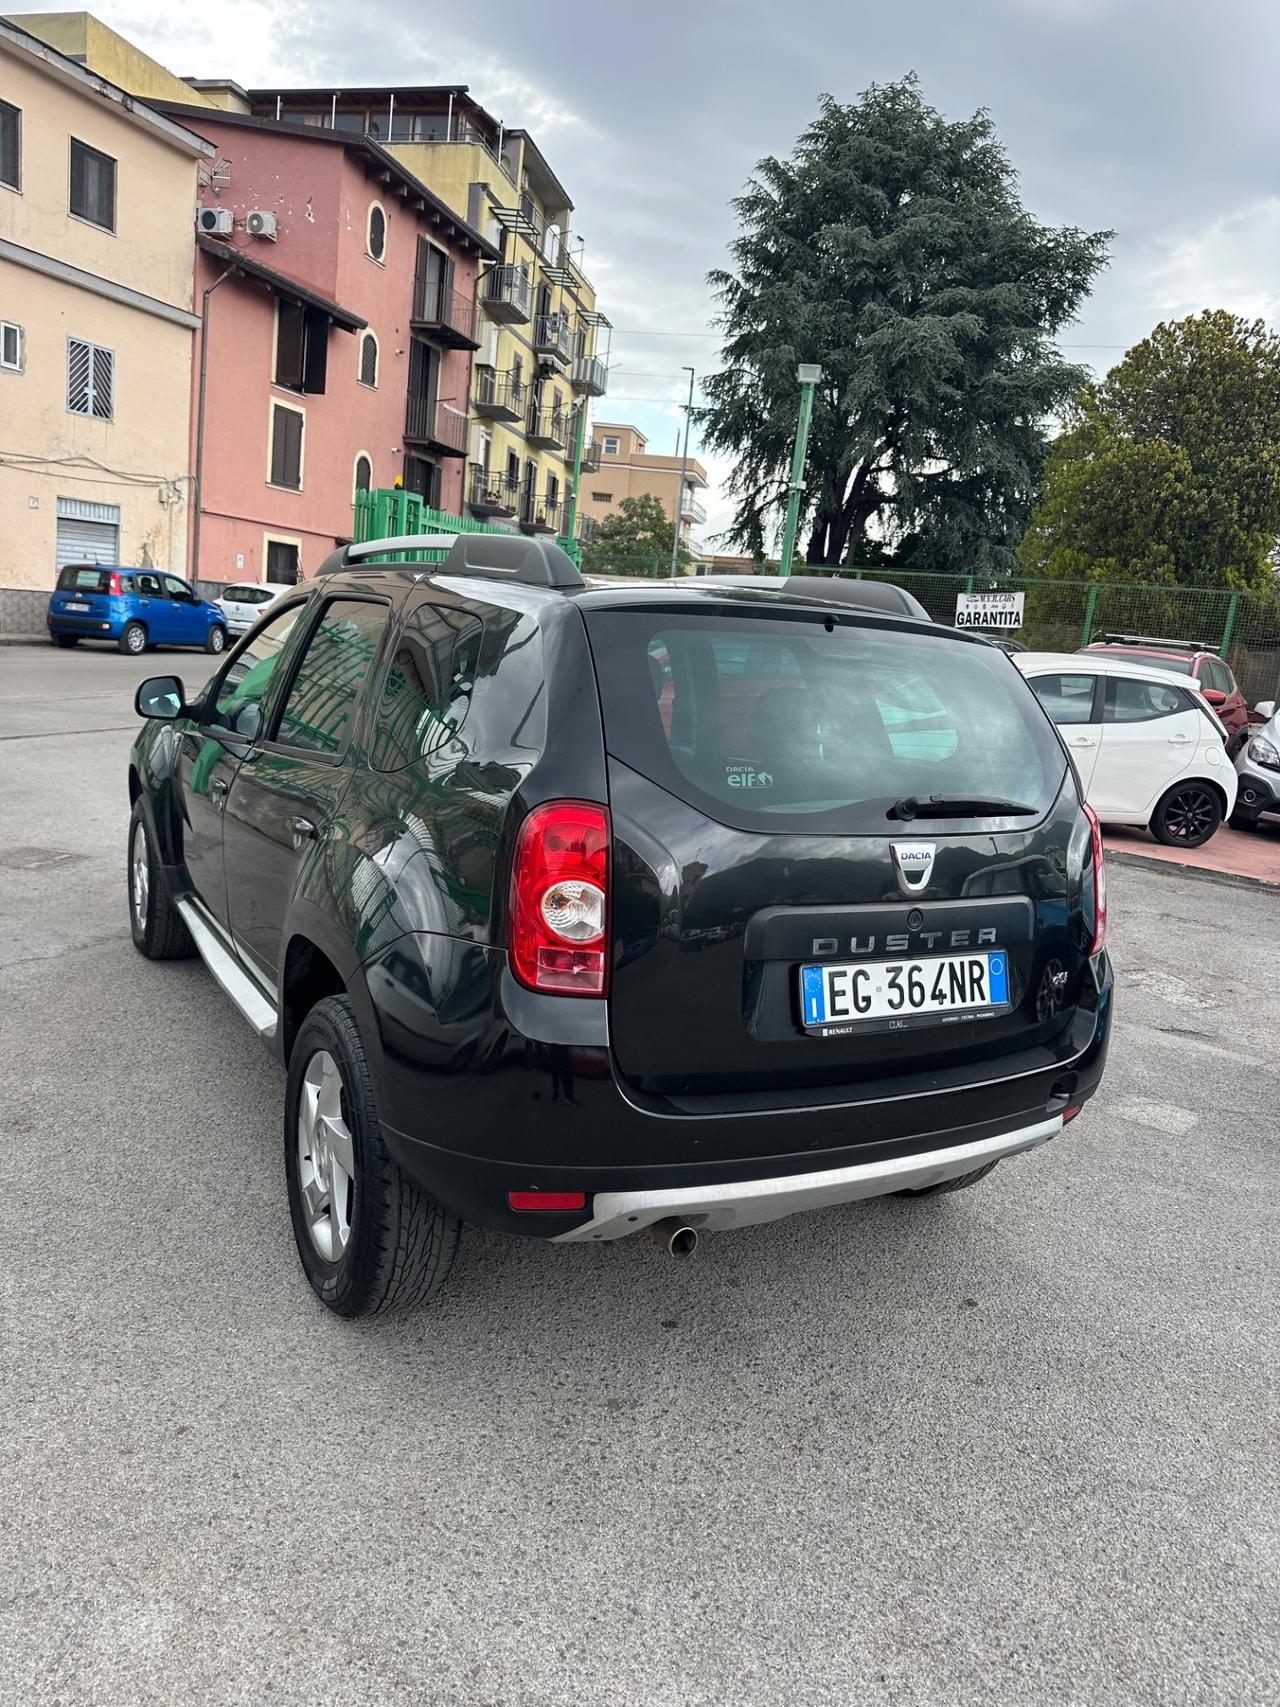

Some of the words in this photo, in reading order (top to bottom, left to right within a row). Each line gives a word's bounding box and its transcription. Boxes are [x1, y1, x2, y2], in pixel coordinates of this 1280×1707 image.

[957, 611, 1021, 626] GARANTITA
[727, 773, 756, 787] elf
[901, 852, 931, 860] DACIA
[812, 928, 997, 955] DUSTER
[828, 969, 872, 1016] EG
[885, 960, 986, 1010] 364NR
[828, 1027, 853, 1035] RENAULT
